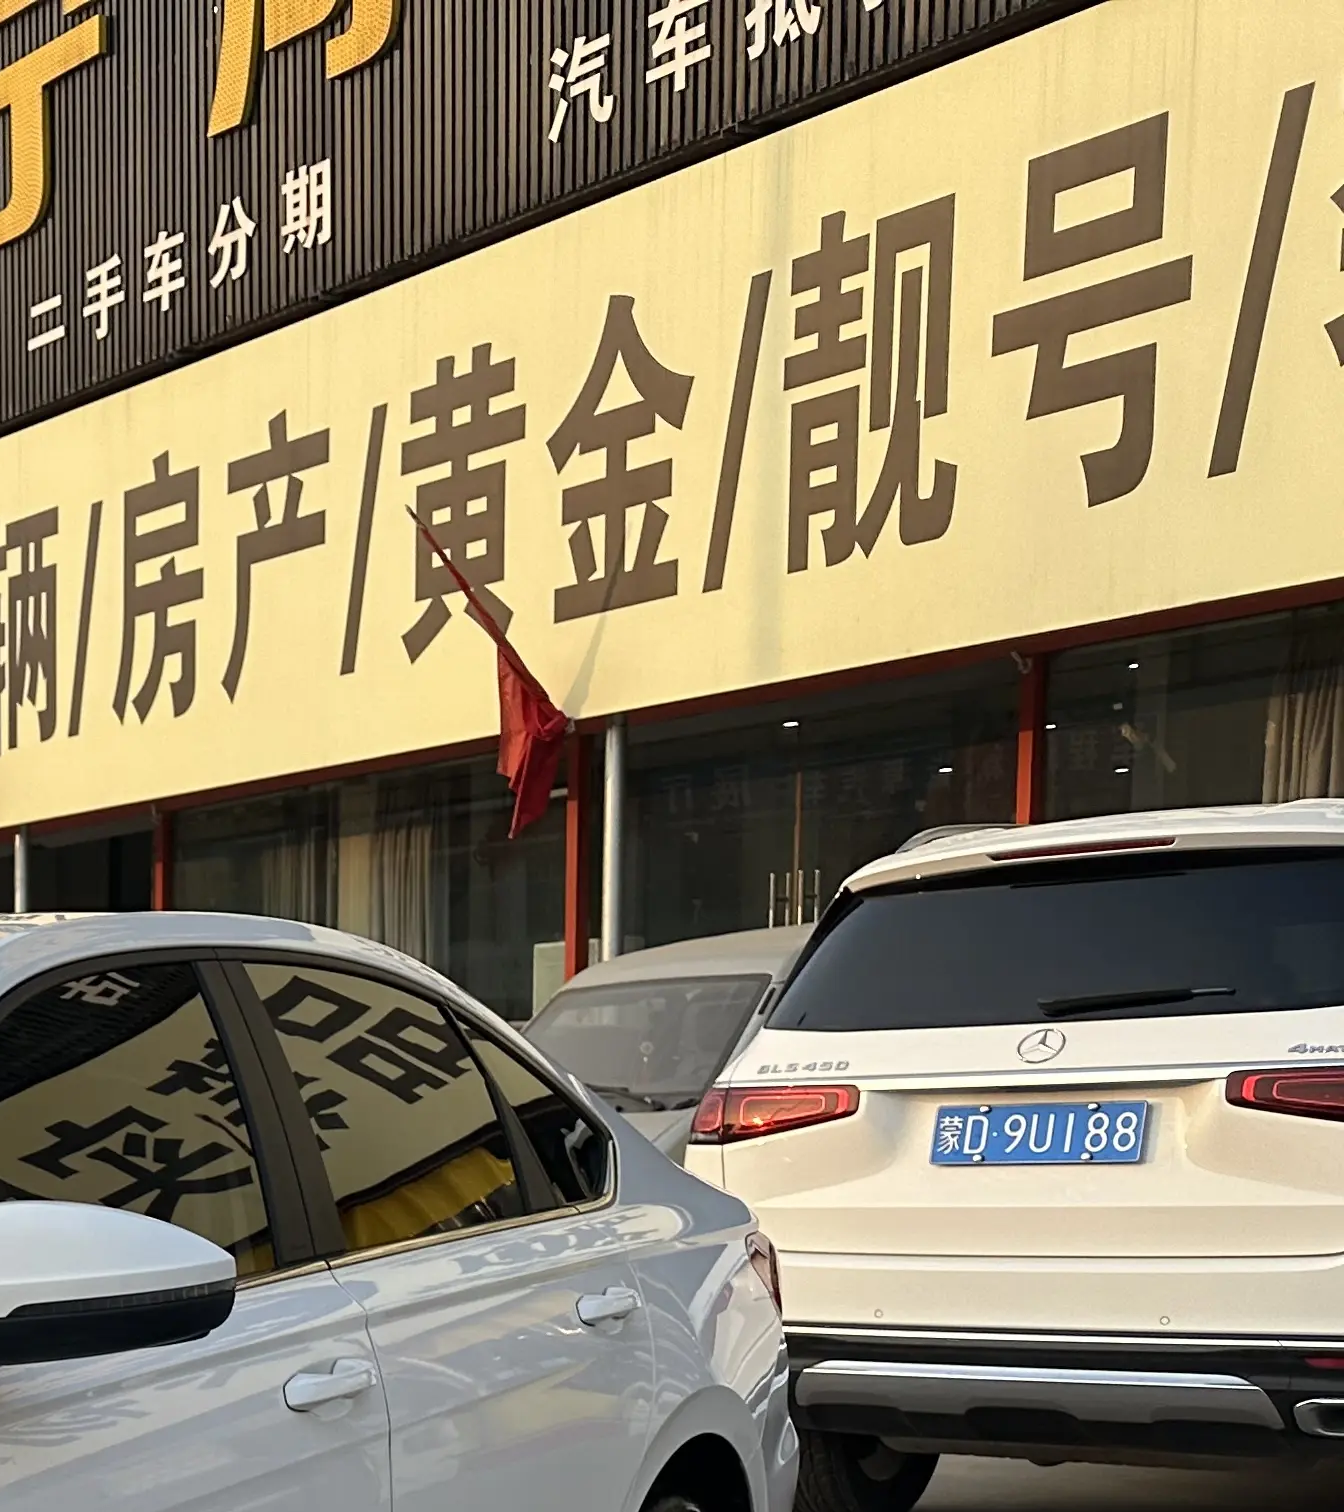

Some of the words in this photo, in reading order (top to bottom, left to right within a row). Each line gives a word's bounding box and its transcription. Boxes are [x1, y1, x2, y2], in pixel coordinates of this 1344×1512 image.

[548, 0, 882, 143] 汽车抵
[27, 158, 332, 351] 二手车分期
